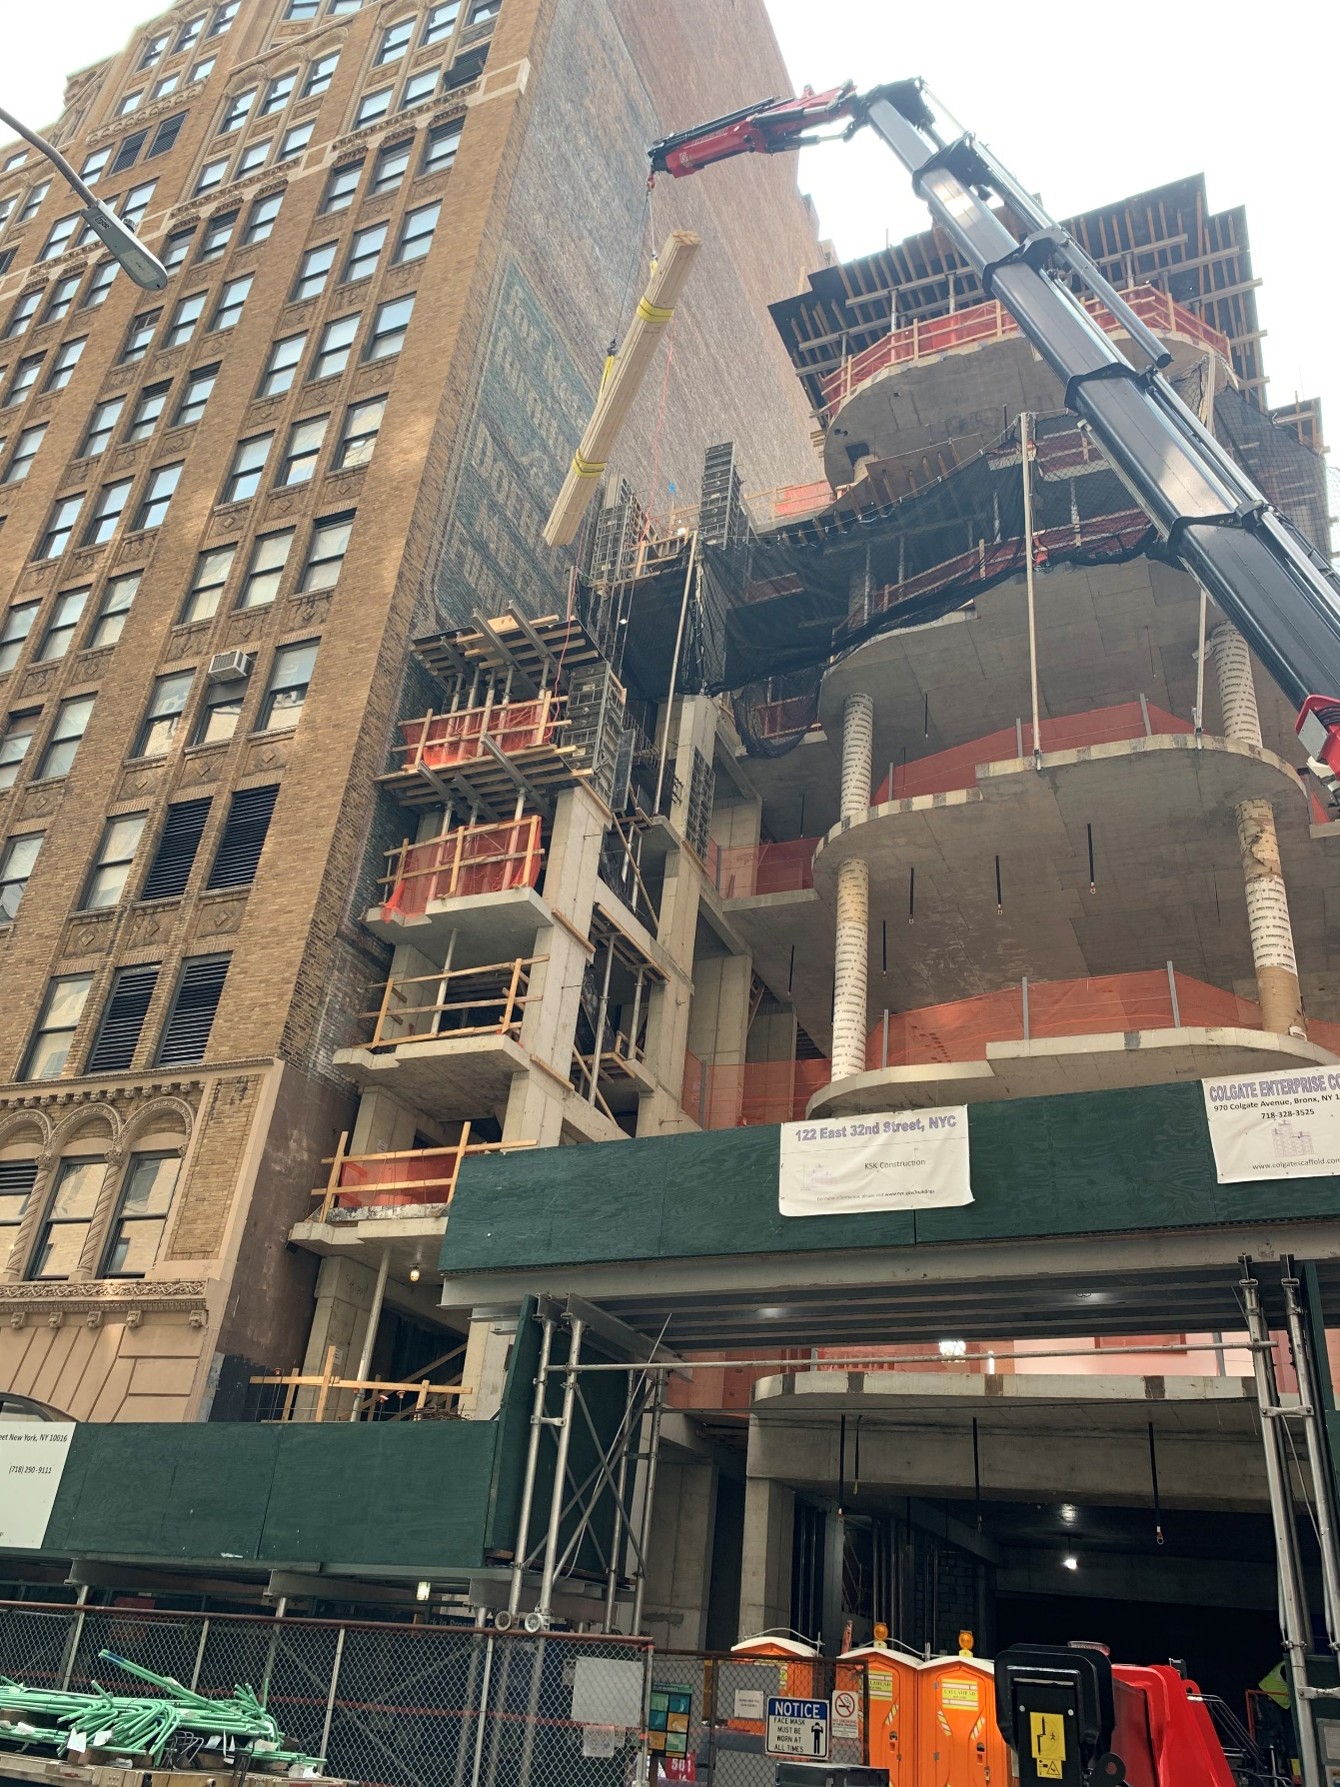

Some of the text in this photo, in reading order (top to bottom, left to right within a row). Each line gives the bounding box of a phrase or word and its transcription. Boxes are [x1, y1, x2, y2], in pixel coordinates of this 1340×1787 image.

[1209, 1082, 1258, 1102] COLGATE
[1259, 1075, 1327, 1097] ENTERPRISE
[1230, 1101, 1258, 1111] Colgate
[1260, 1098, 1292, 1107] Avenue,
[1294, 1096, 1320, 1105] Bronx,
[1261, 1108, 1315, 1119] 718-328-3525
[795, 1115, 957, 1142] 122 East 32nd Street, NYC
[864, 1158, 926, 1170] KSK Construction
[24, 1433, 38, 1442] York,
[774, 1701, 820, 1719] NOTICE
[773, 1717, 805, 1726] FACE MASK
[777, 1726, 801, 1735] MUST BE
[777, 1735, 793, 1743] WORN
[774, 1744, 785, 1752] ALL
